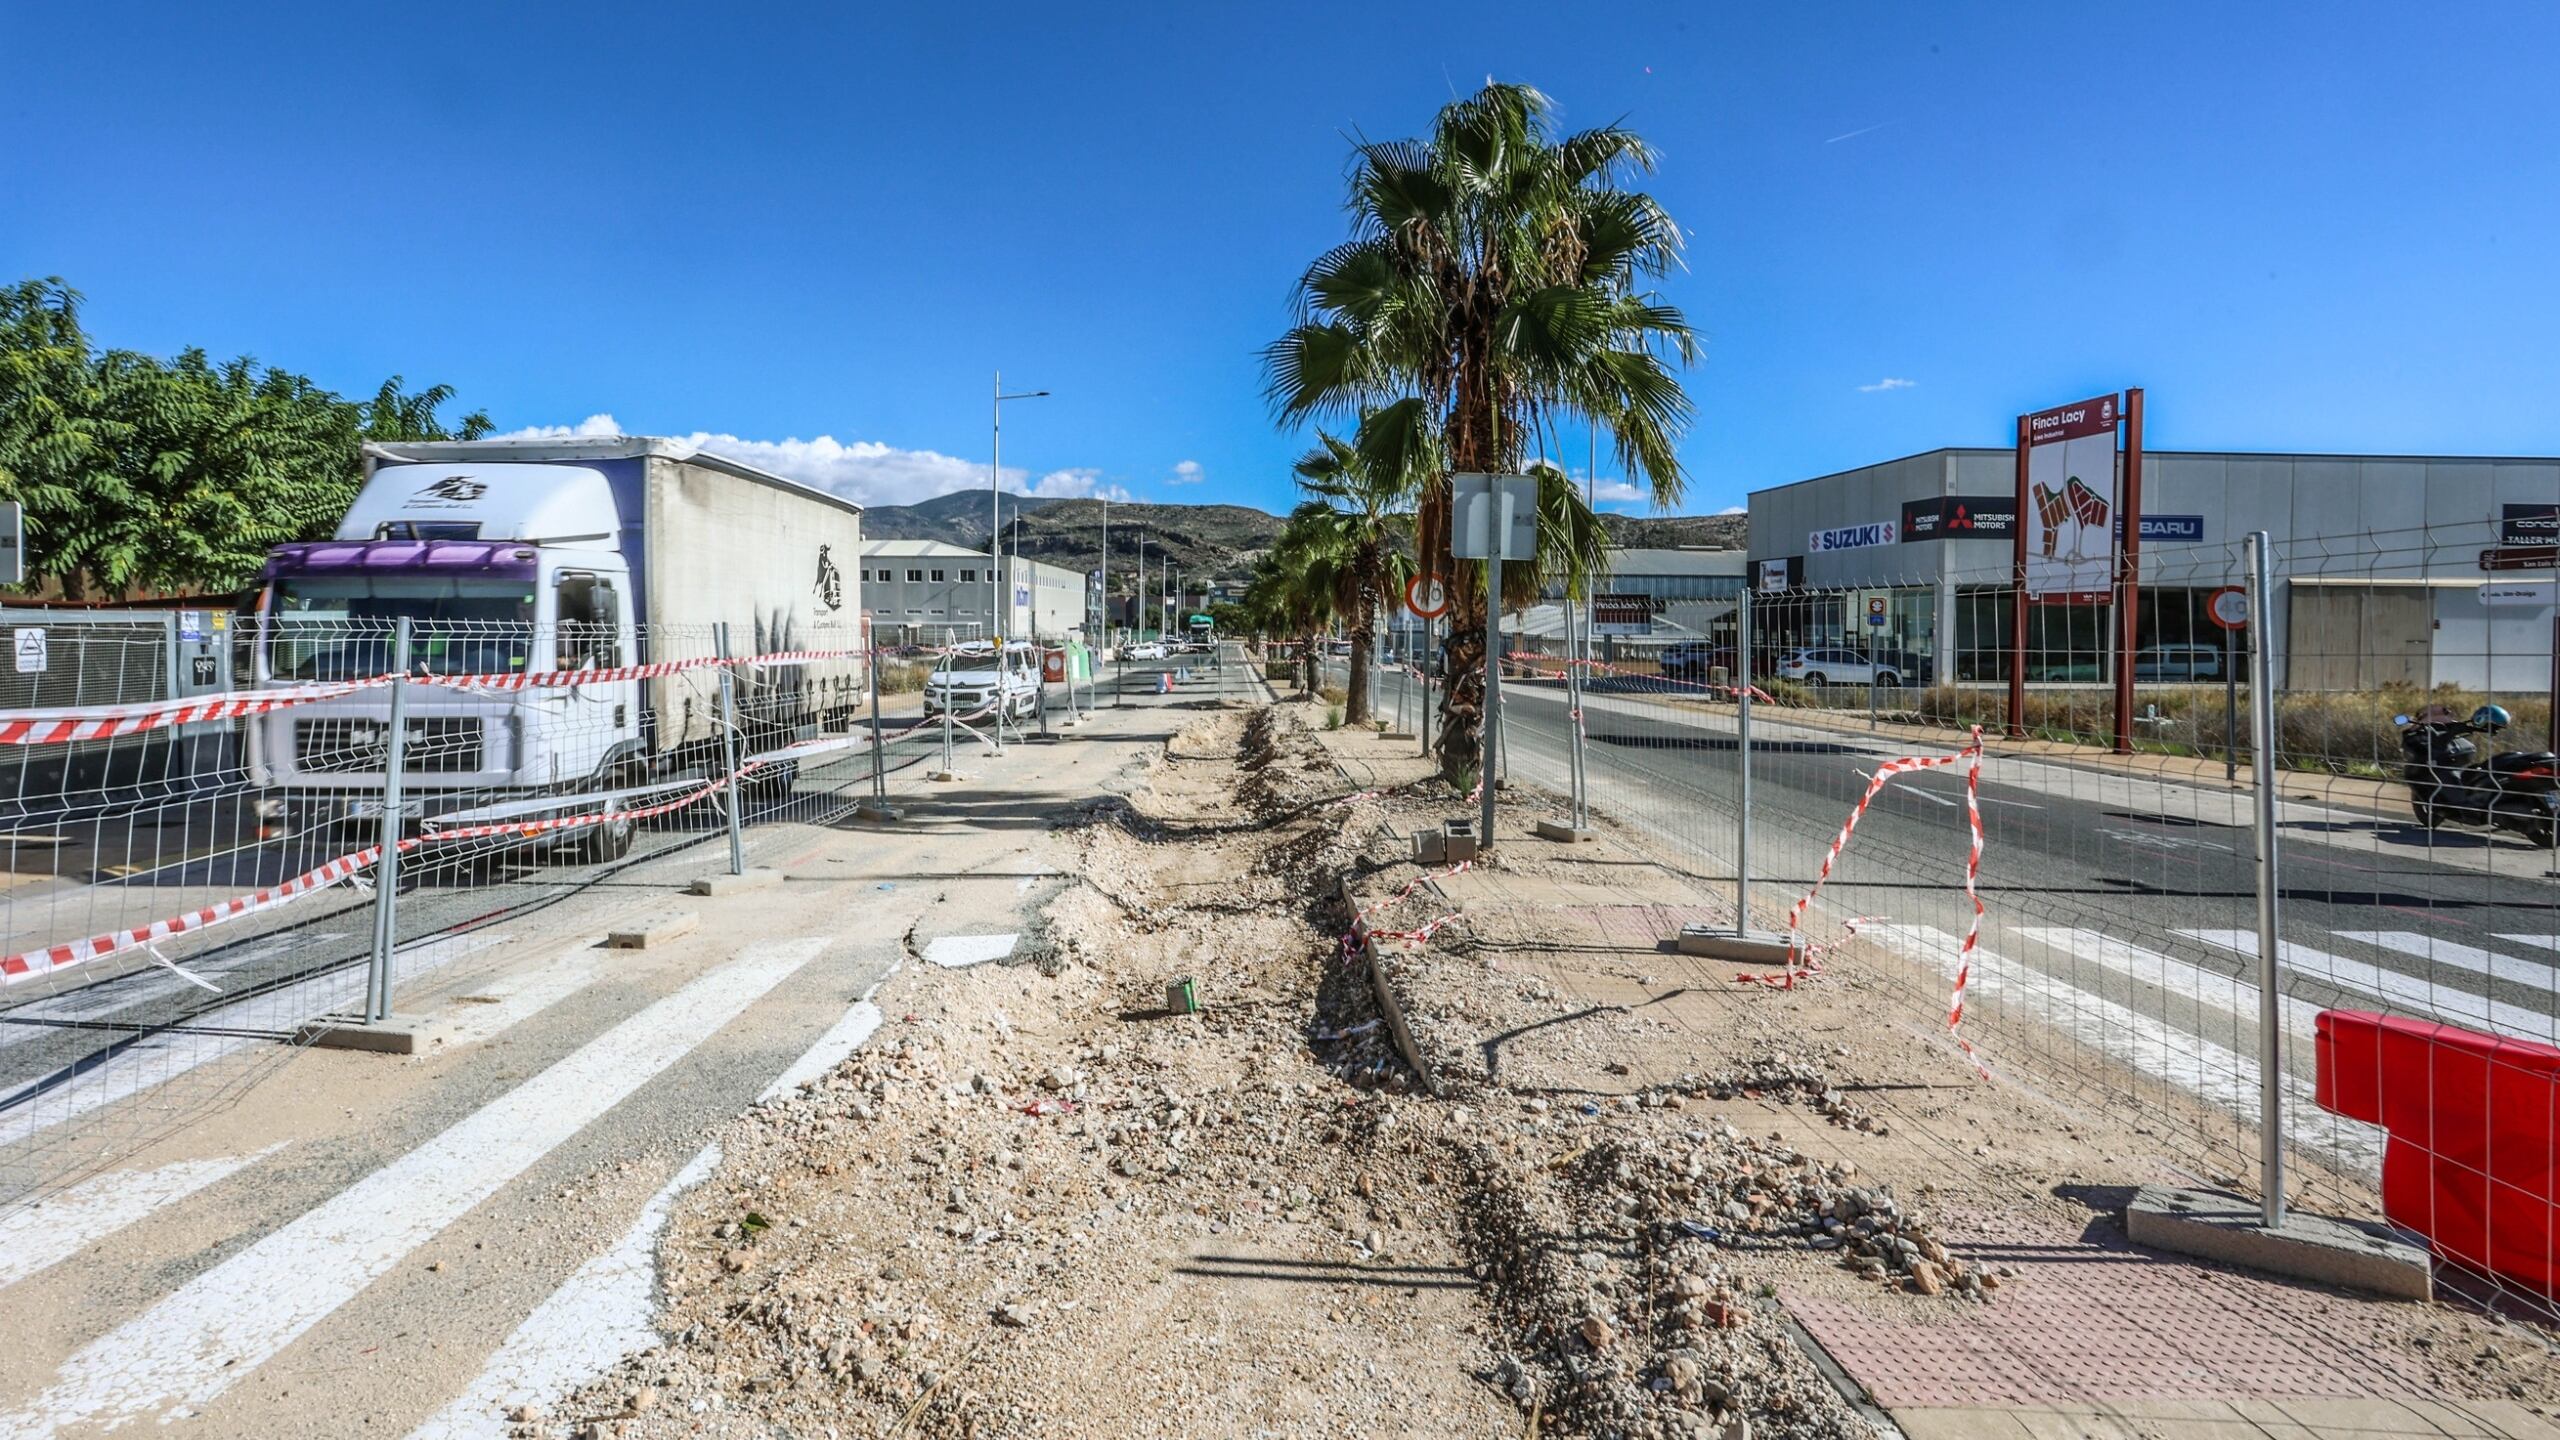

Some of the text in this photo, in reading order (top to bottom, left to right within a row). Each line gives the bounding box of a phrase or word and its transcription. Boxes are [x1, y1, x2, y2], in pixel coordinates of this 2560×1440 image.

[2032, 416, 2059, 430] Finca
[2061, 409, 2086, 424] Lacy
[1973, 521, 2006, 530] MOTORS
[1823, 525, 1880, 549] SUZUKI
[2507, 535, 2543, 544] TALLER
